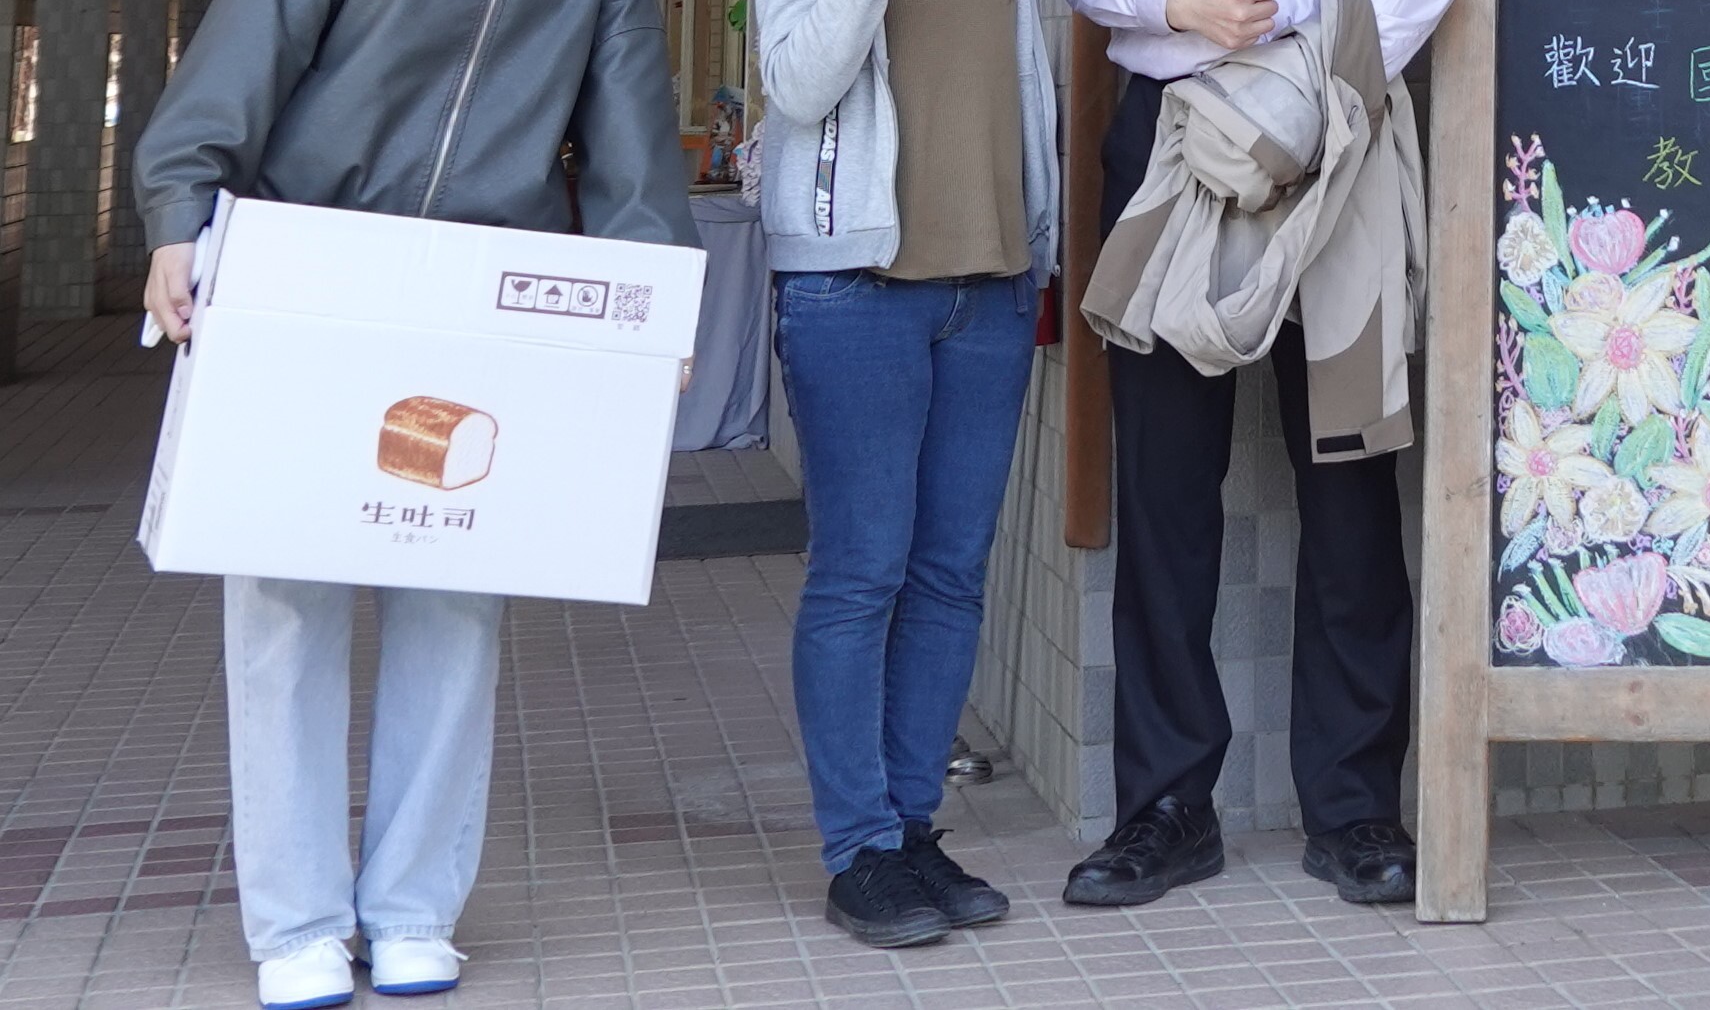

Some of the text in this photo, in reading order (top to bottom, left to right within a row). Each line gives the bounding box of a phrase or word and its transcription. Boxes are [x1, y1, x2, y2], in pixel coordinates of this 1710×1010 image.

[1543, 34, 1660, 90] 歡迎
[360, 501, 475, 531] 生吐司
[390, 531, 439, 544] 生食パン
